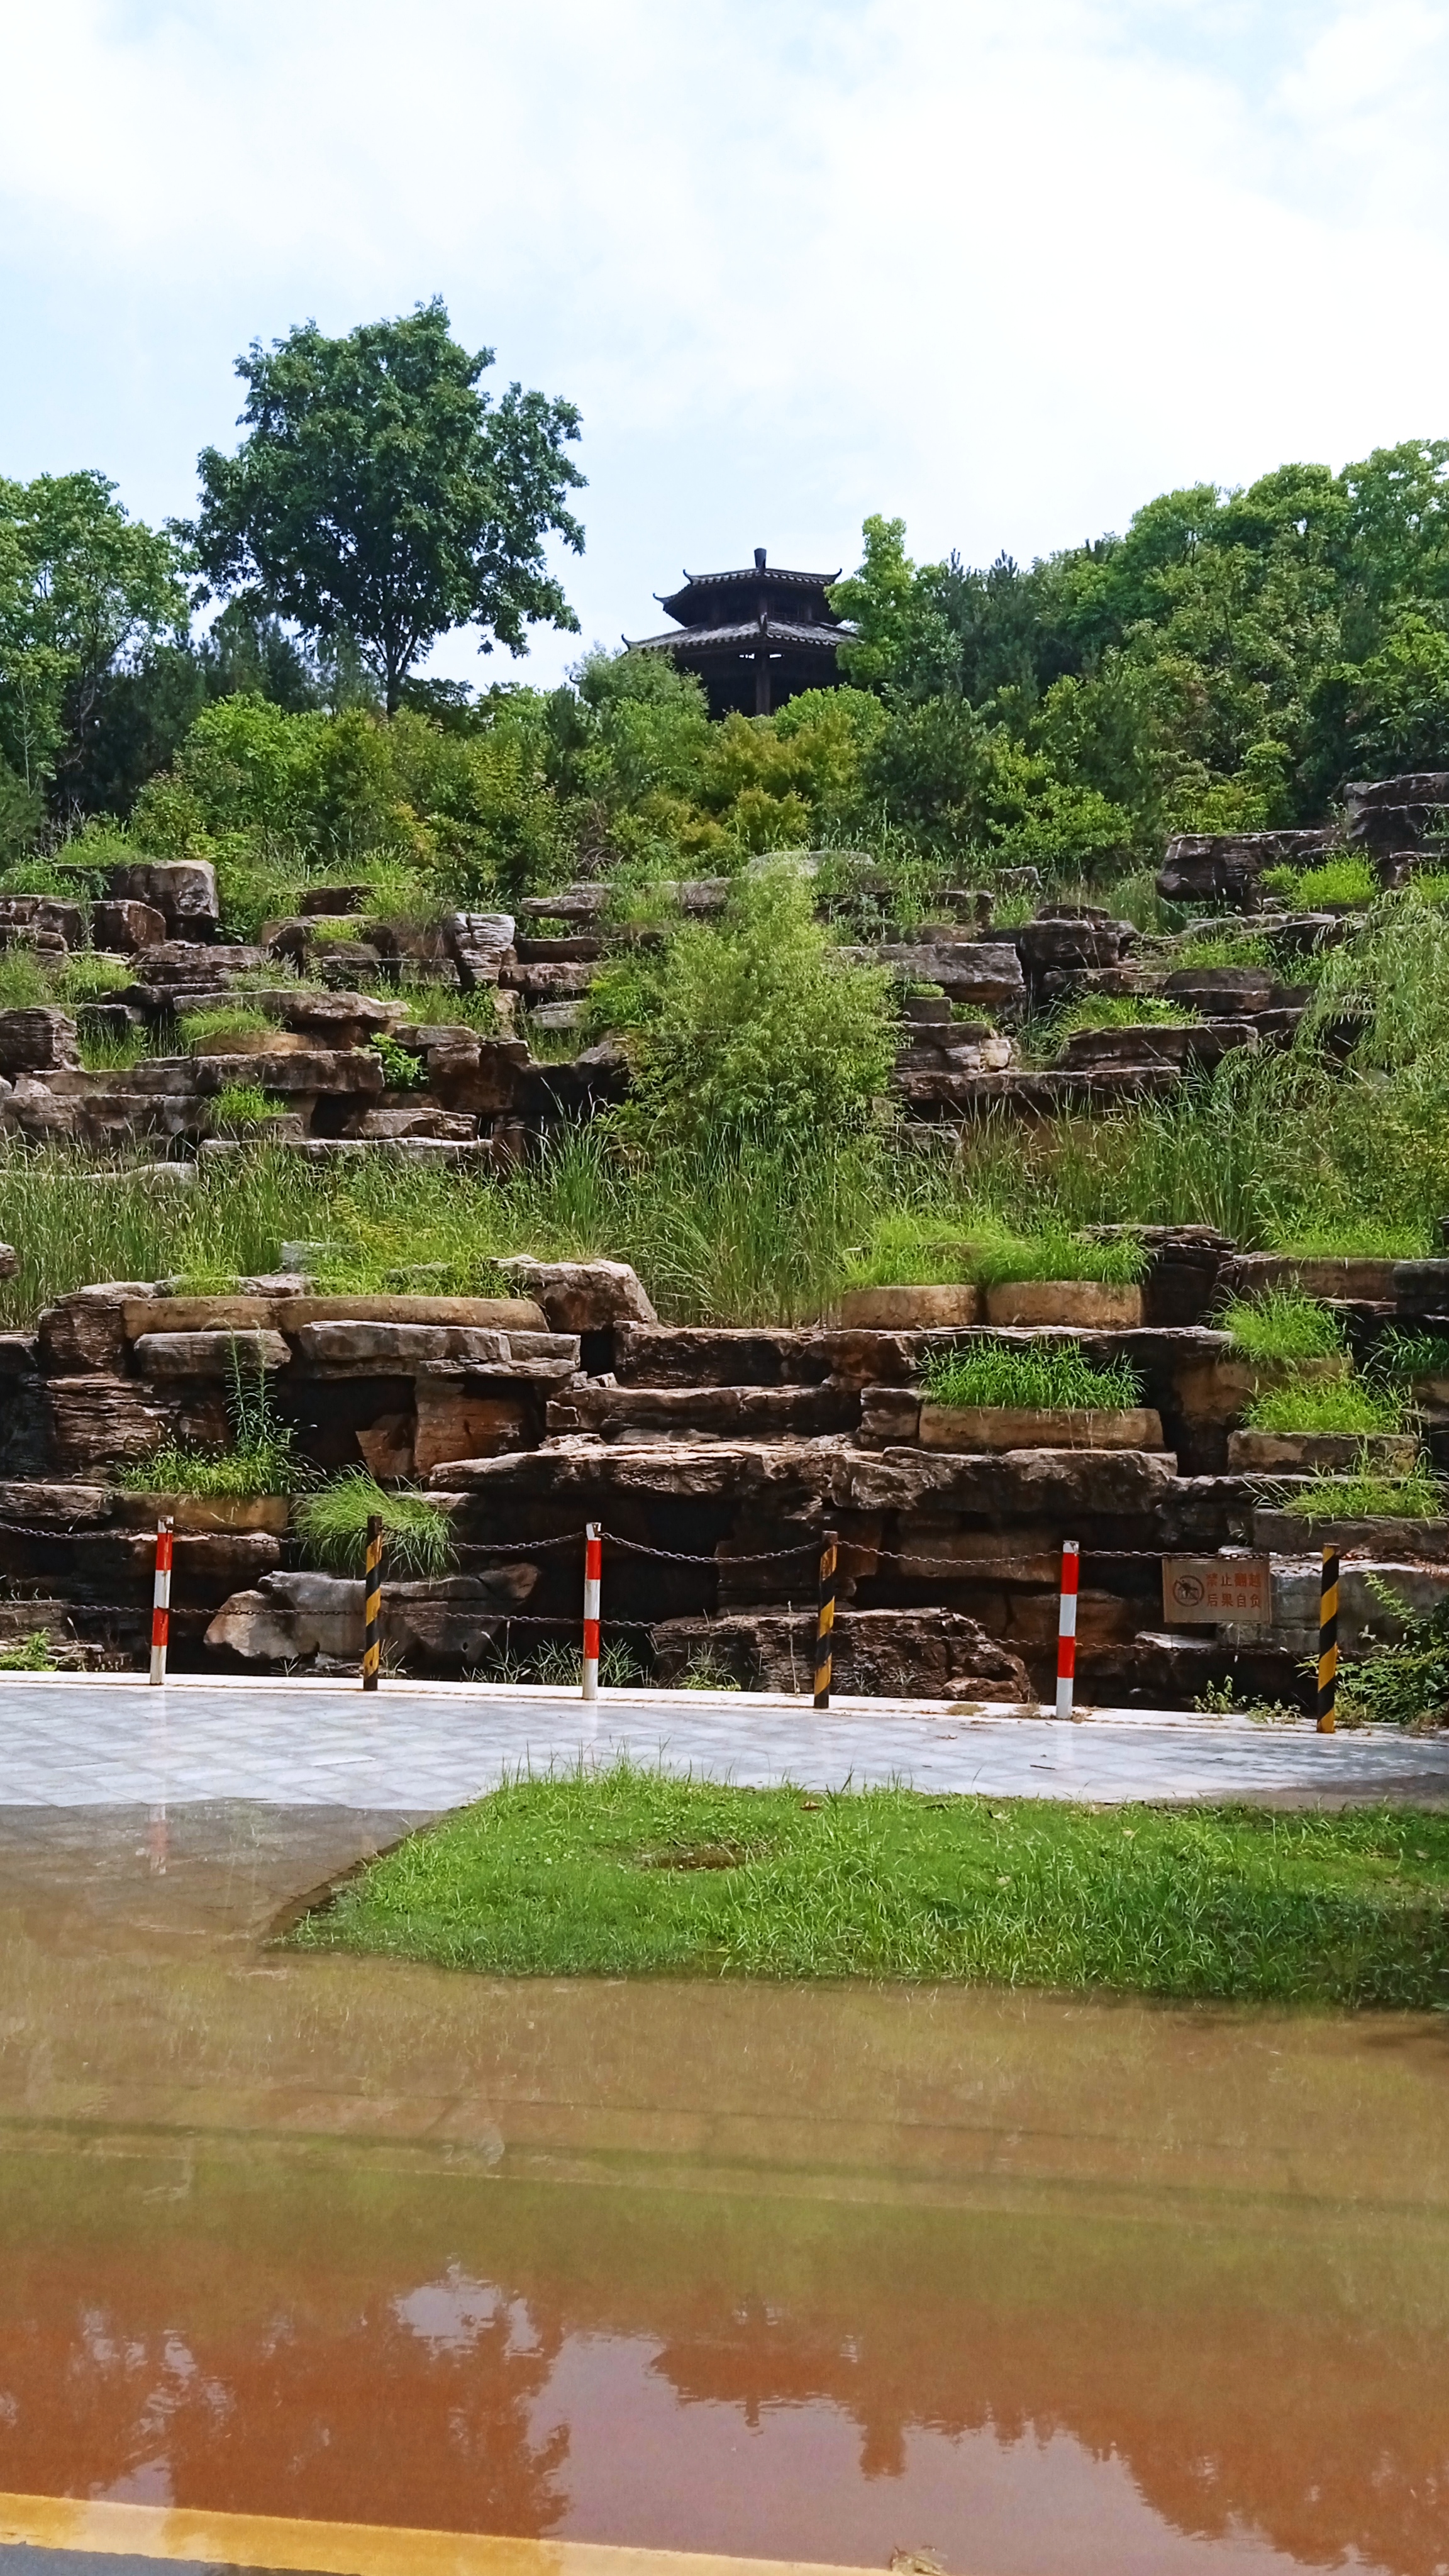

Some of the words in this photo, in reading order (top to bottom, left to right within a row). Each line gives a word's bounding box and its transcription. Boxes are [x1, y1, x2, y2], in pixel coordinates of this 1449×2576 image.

[1206, 1573, 1261, 1587] 禁止翻越
[1208, 1593, 1262, 1608] 后果自负
